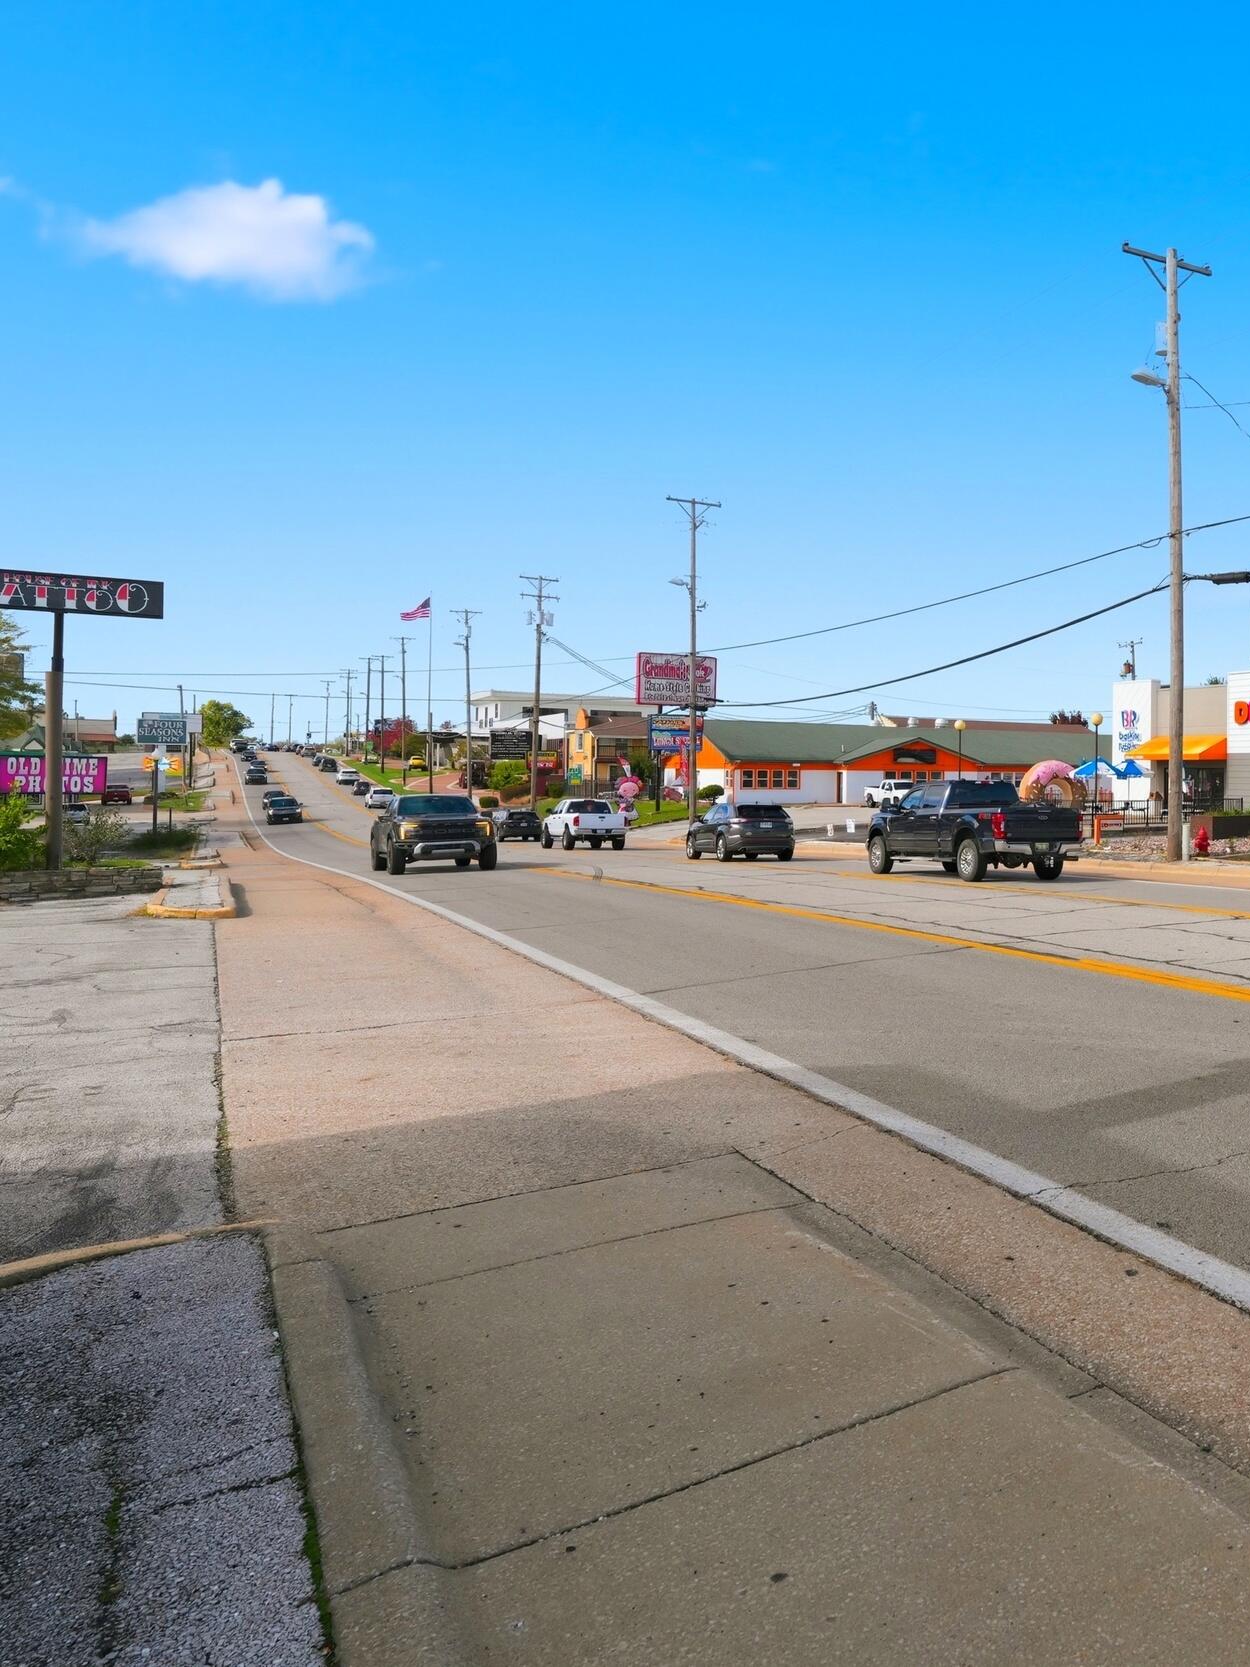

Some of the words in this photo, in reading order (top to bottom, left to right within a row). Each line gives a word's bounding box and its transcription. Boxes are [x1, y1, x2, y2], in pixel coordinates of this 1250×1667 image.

[0, 582, 150, 614] ATTOO
[138, 727, 185, 737] SEASONS
[154, 720, 184, 729] FOUR
[7, 757, 41, 775] OLD
[62, 757, 98, 776] IME
[14, 775, 94, 793] PHTOS
